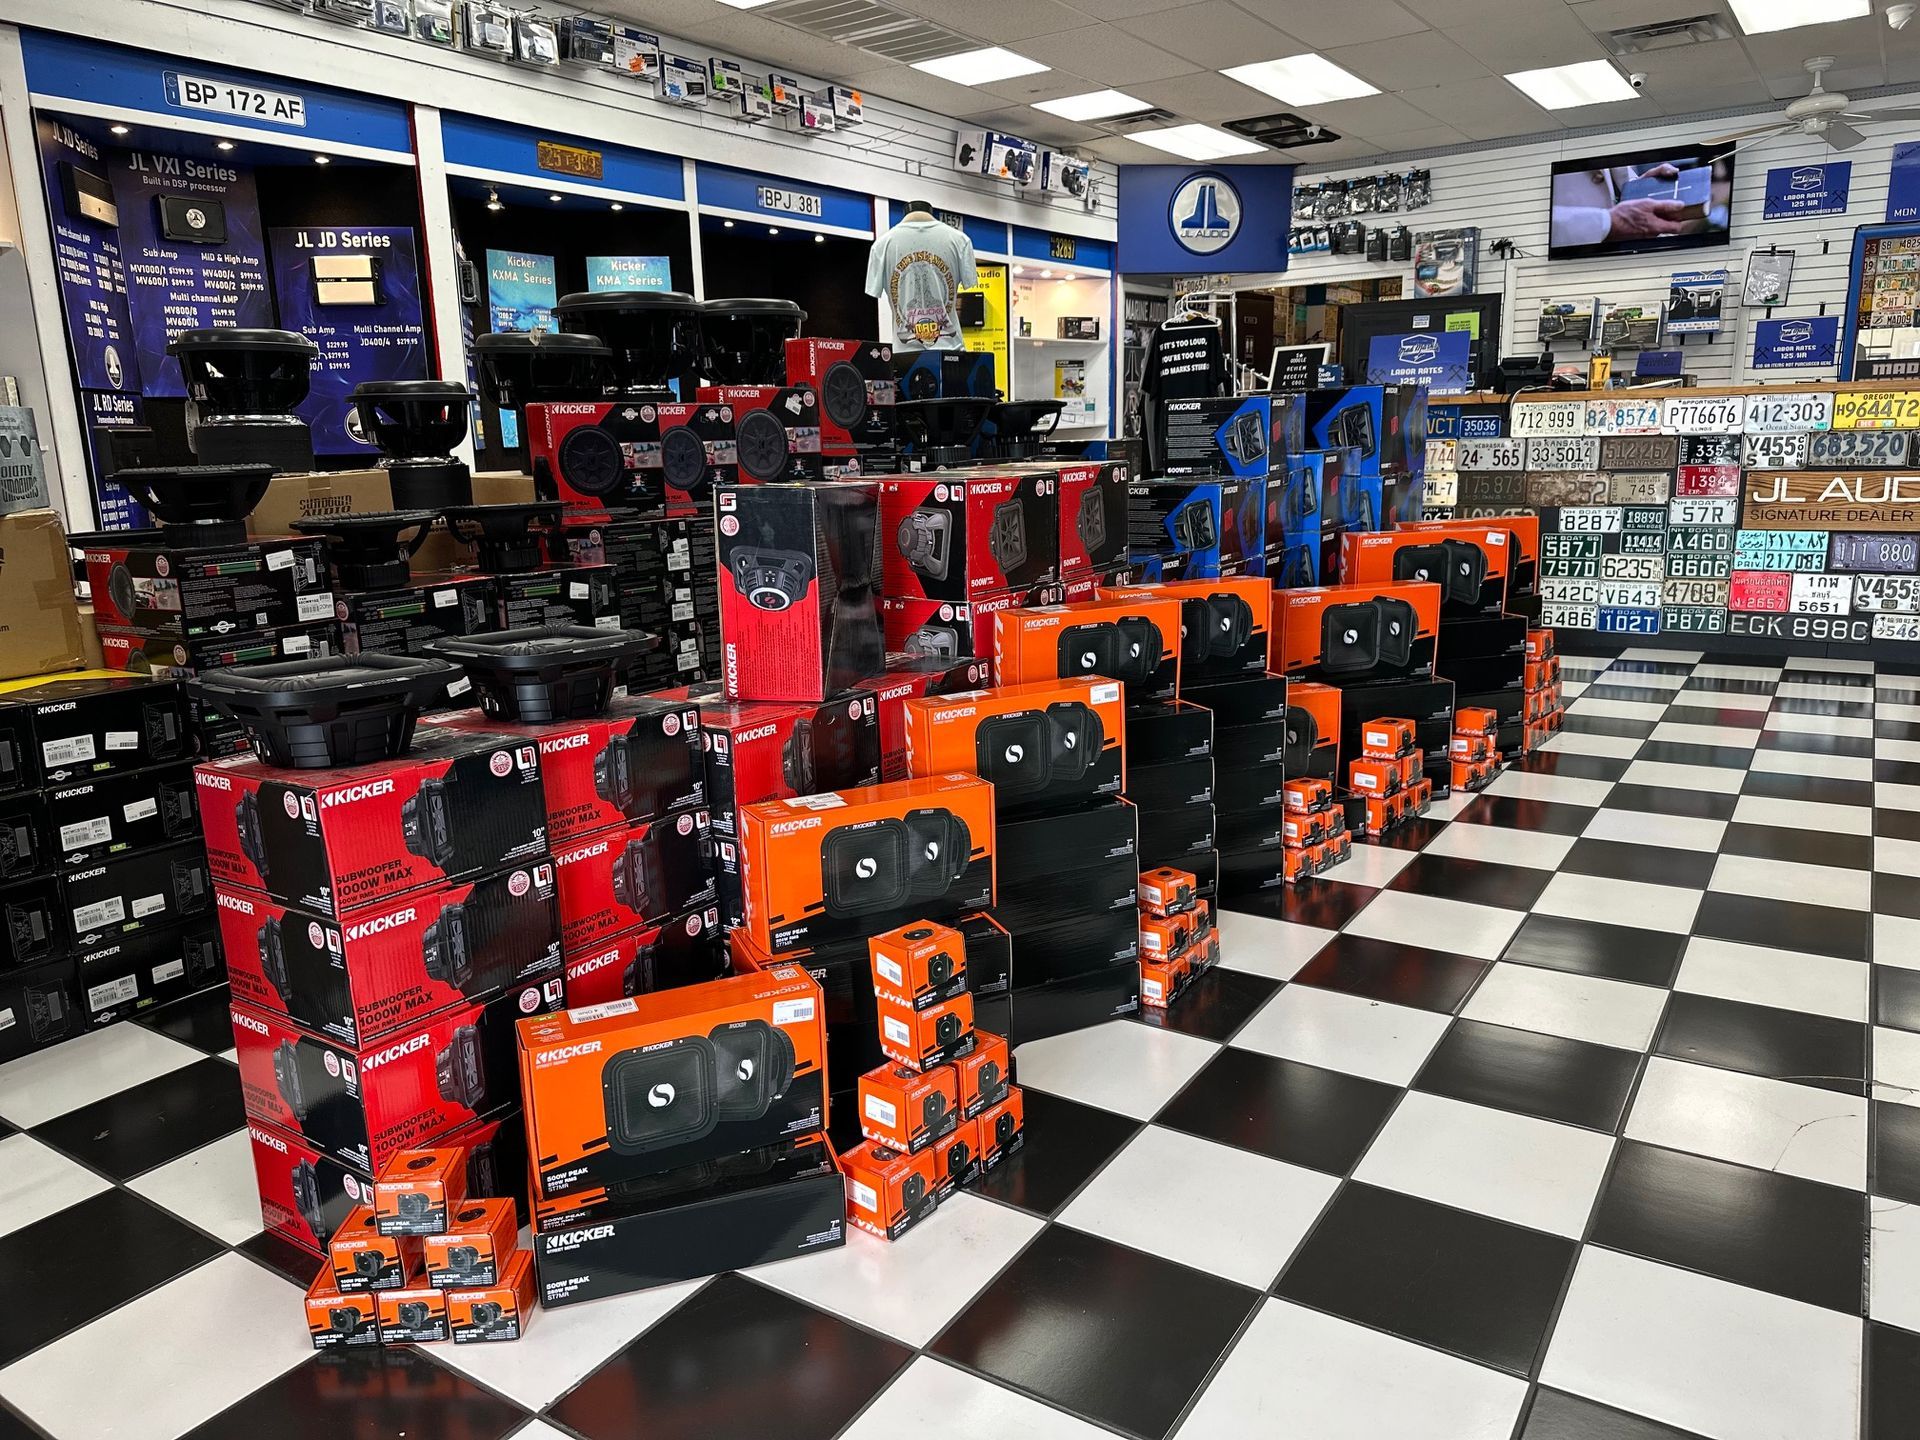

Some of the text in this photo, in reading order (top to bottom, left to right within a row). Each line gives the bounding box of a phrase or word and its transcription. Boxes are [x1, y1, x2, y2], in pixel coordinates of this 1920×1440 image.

[186, 81, 300, 120] BP 172 AF
[53, 121, 98, 160] JL XD Series
[129, 153, 237, 182] JL VXI Series
[143, 176, 227, 193] Built in DSP processor
[765, 188, 820, 213] BPJ 381
[1894, 208, 1917, 217] MON
[295, 231, 391, 248] JL JD Series
[1180, 230, 1230, 238] JL AUDIO
[143, 248, 178, 260] Sub Amp
[217, 254, 223, 262] &
[224, 255, 240, 265] High
[242, 256, 259, 266] Amp
[507, 256, 536, 268] Kicker
[130, 264, 166, 276] MV1000/1
[611, 261, 646, 271] Kicker
[136, 276, 169, 287] MV600/1
[202, 269, 235, 280] MV400/4
[492, 269, 552, 285] KXMA Series
[597, 275, 663, 286] KMA Series
[204, 280, 236, 291] MV600/2
[170, 292, 239, 304] Multi channel AMP
[164, 306, 198, 316] MV800/8
[302, 326, 336, 336] Sub Amp
[353, 325, 422, 335] Multi Channel Amp
[360, 338, 391, 347] JD400/4
[823, 342, 845, 351] KICKER
[1164, 337, 1208, 350] IT'S TOO LOUD,
[1182, 350, 1207, 360] TOO OLD
[1170, 365, 1191, 374] MARKS
[1391, 366, 1443, 376] LABOR RATES
[733, 389, 760, 398] KICKER
[93, 394, 134, 413] JL RD Series
[559, 404, 596, 415] KICKER
[1174, 402, 1201, 411] KICKER
[1836, 399, 1920, 418] H964472
[1588, 408, 1657, 427] 82 8574
[1670, 405, 1736, 425] P776676
[1750, 402, 1825, 423] 412-303
[1427, 417, 1456, 434] VCT
[1464, 420, 1497, 432] 35036
[1493, 449, 1520, 467] 565
[1696, 445, 1723, 457] 335
[1065, 470, 1088, 483] KICKER
[1691, 475, 1727, 488] 1394
[973, 482, 1003, 495] KICKER
[1752, 477, 1806, 503] JL
[299, 495, 352, 510] SUNDOWN
[1627, 511, 1664, 524] 18890
[1682, 506, 1724, 522] 57R
[1750, 509, 1914, 522] SIGNATURE DEALER
[1565, 515, 1616, 531] 8287
[1546, 541, 1597, 557] 587J
[1625, 535, 1662, 548] 11414
[1673, 533, 1728, 550] A460
[1840, 542, 1911, 562] 111 880
[1545, 560, 1595, 576] 797D
[1605, 558, 1653, 579] 6235
[1671, 560, 1728, 577] 860G
[1765, 553, 1824, 571] 217083
[1293, 595, 1322, 605] KICKER
[1544, 586, 1594, 601] 342C
[1605, 589, 1656, 606] V643
[1798, 601, 1840, 613] 5651
[1542, 610, 1592, 627] 6486
[1605, 615, 1655, 632] 102T
[1667, 613, 1720, 630] P876
[1730, 614, 1868, 641] EGK 898C
[728, 643, 737, 687] KICKER
[886, 685, 913, 699] KICKER
[45, 702, 76, 713] KICKER
[942, 707, 977, 719] KICKER
[742, 724, 777, 742] KICKER
[543, 733, 590, 754] KICKER
[202, 773, 232, 791] KICKER
[62, 785, 94, 799] KICKER
[336, 780, 395, 804] KICKER
[780, 817, 822, 831] KICKER
[565, 842, 608, 865] KICKER
[336, 859, 402, 885] SUBWOOFER
[337, 866, 413, 898] 1000W MAX
[224, 896, 255, 916] KICKER
[358, 907, 418, 939] KICKER
[373, 1034, 431, 1065] KICKER
[548, 1041, 602, 1062] KICKER
[546, 1167, 589, 1183] 500W PEAK
[558, 1224, 615, 1247] KICKER
